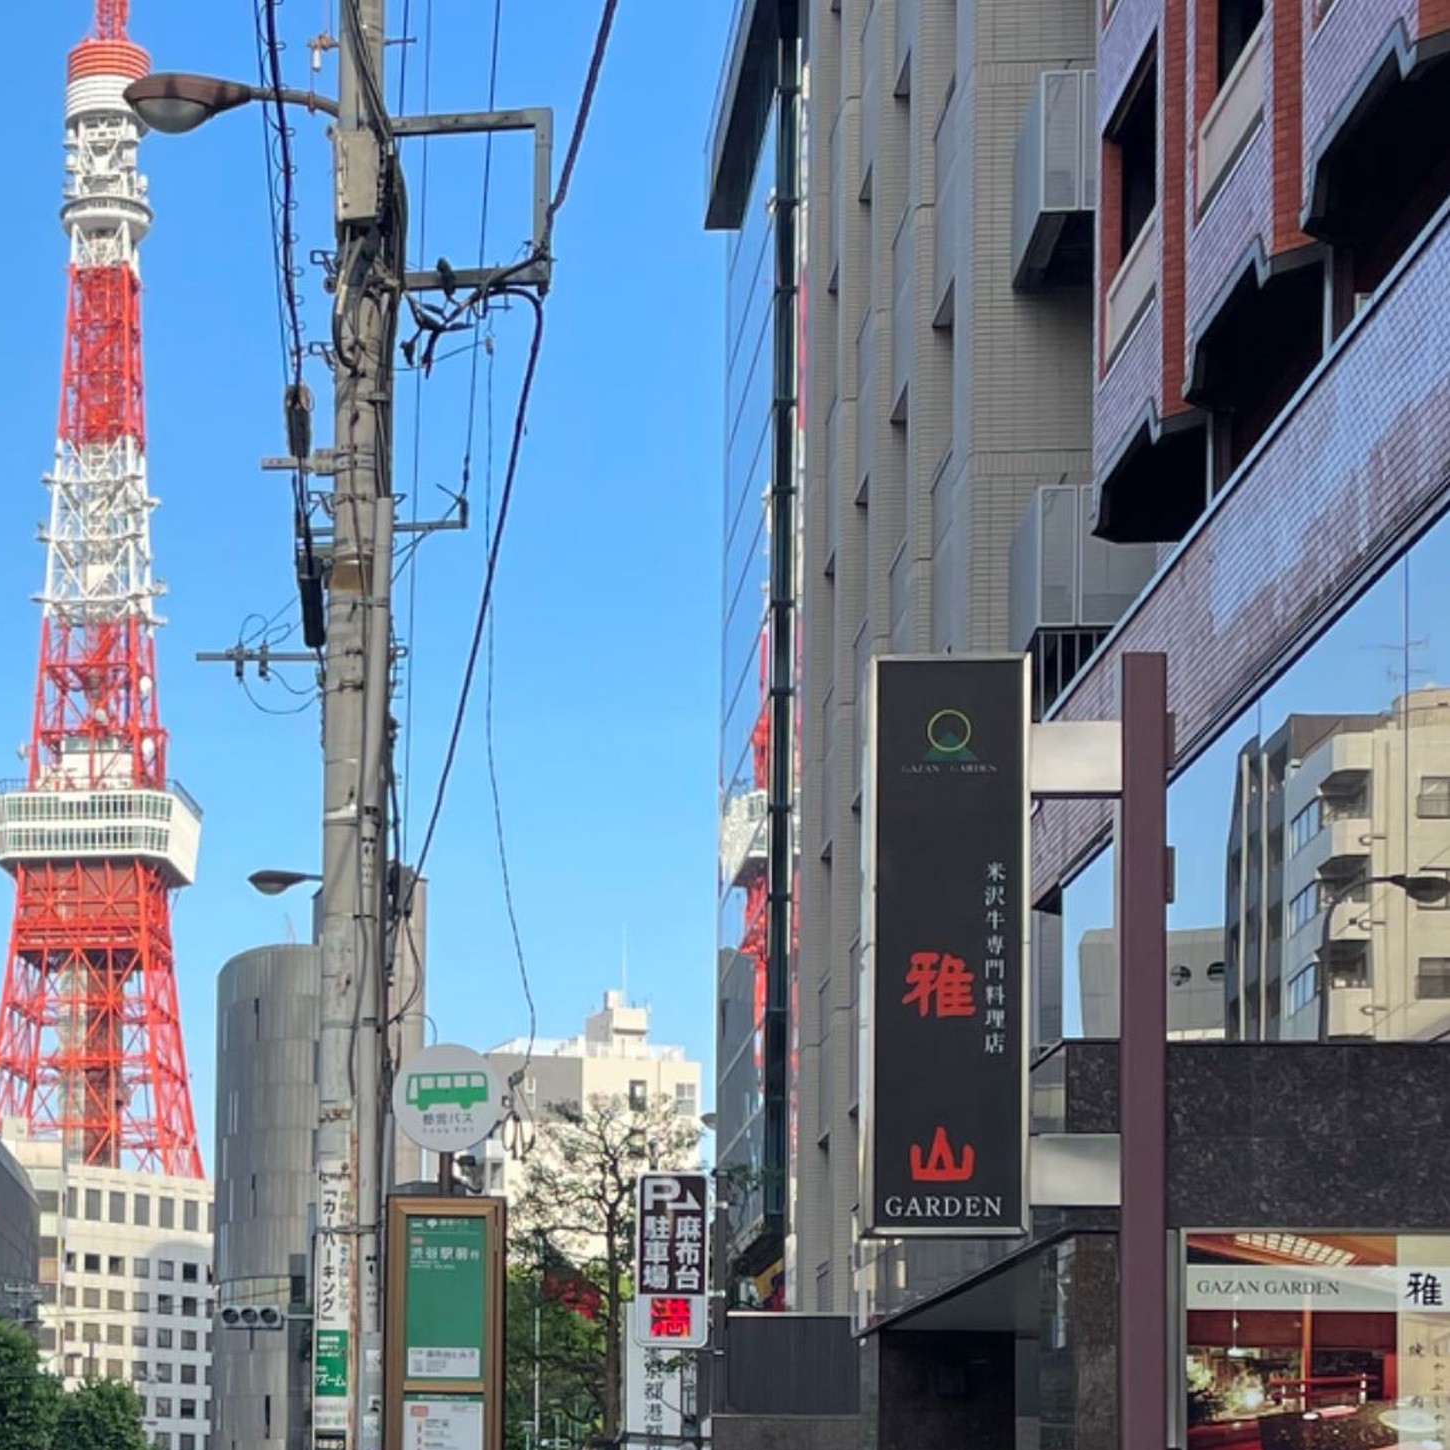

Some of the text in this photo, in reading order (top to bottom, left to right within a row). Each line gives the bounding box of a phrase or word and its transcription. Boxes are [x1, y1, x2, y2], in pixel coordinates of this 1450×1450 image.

[984, 861, 1006, 1054] 米沢牛専門料理店
[902, 952, 977, 1018] 雅
[422, 1112, 473, 1125] 都営バス
[644, 1178, 681, 1210] P
[885, 1196, 1002, 1217] GARDEN
[643, 1216, 670, 1289] 駐車場
[675, 1216, 702, 1290] 麻布台
[1197, 1280, 1340, 1296] GAZAN GARDEN
[1405, 1272, 1443, 1306] 雅
[650, 1298, 691, 1338] 満
